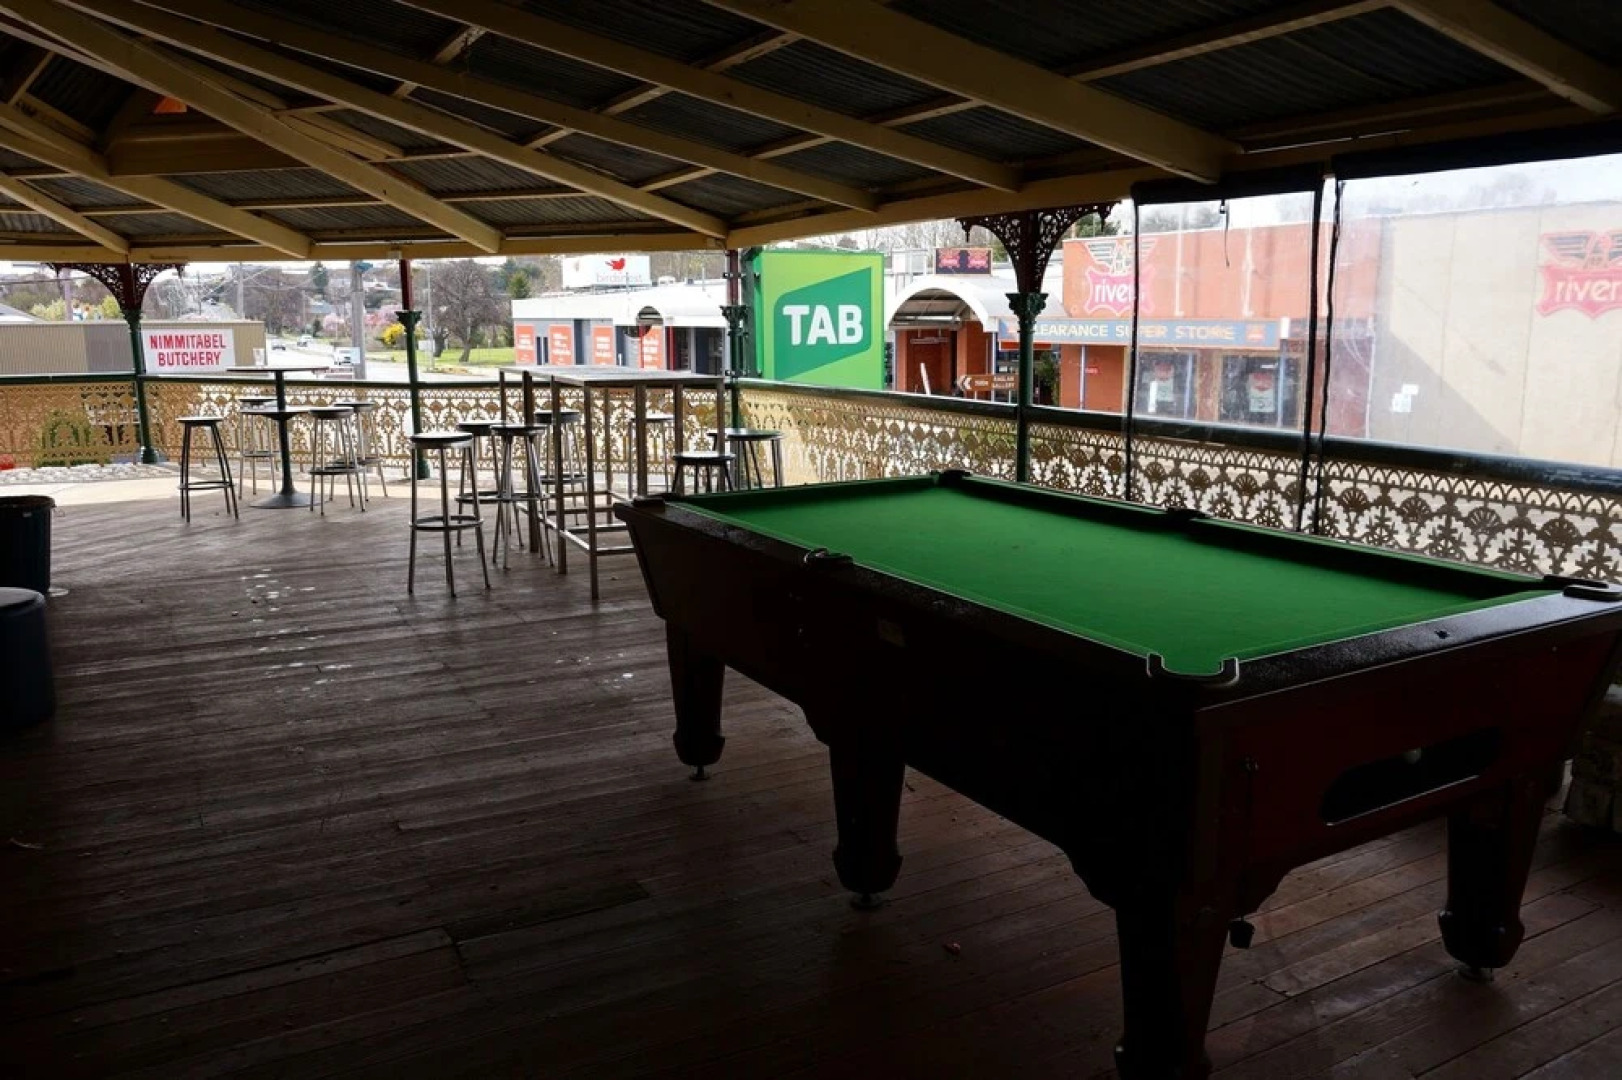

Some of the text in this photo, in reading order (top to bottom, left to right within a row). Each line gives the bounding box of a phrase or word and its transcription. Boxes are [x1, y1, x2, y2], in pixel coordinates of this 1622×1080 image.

[783, 304, 863, 345] TAB
[1032, 324, 1108, 337] LEARANCE
[1175, 325, 1235, 340] STORE
[150, 333, 226, 349] NIMMITABEL
[158, 351, 221, 366] BUTCHERY
